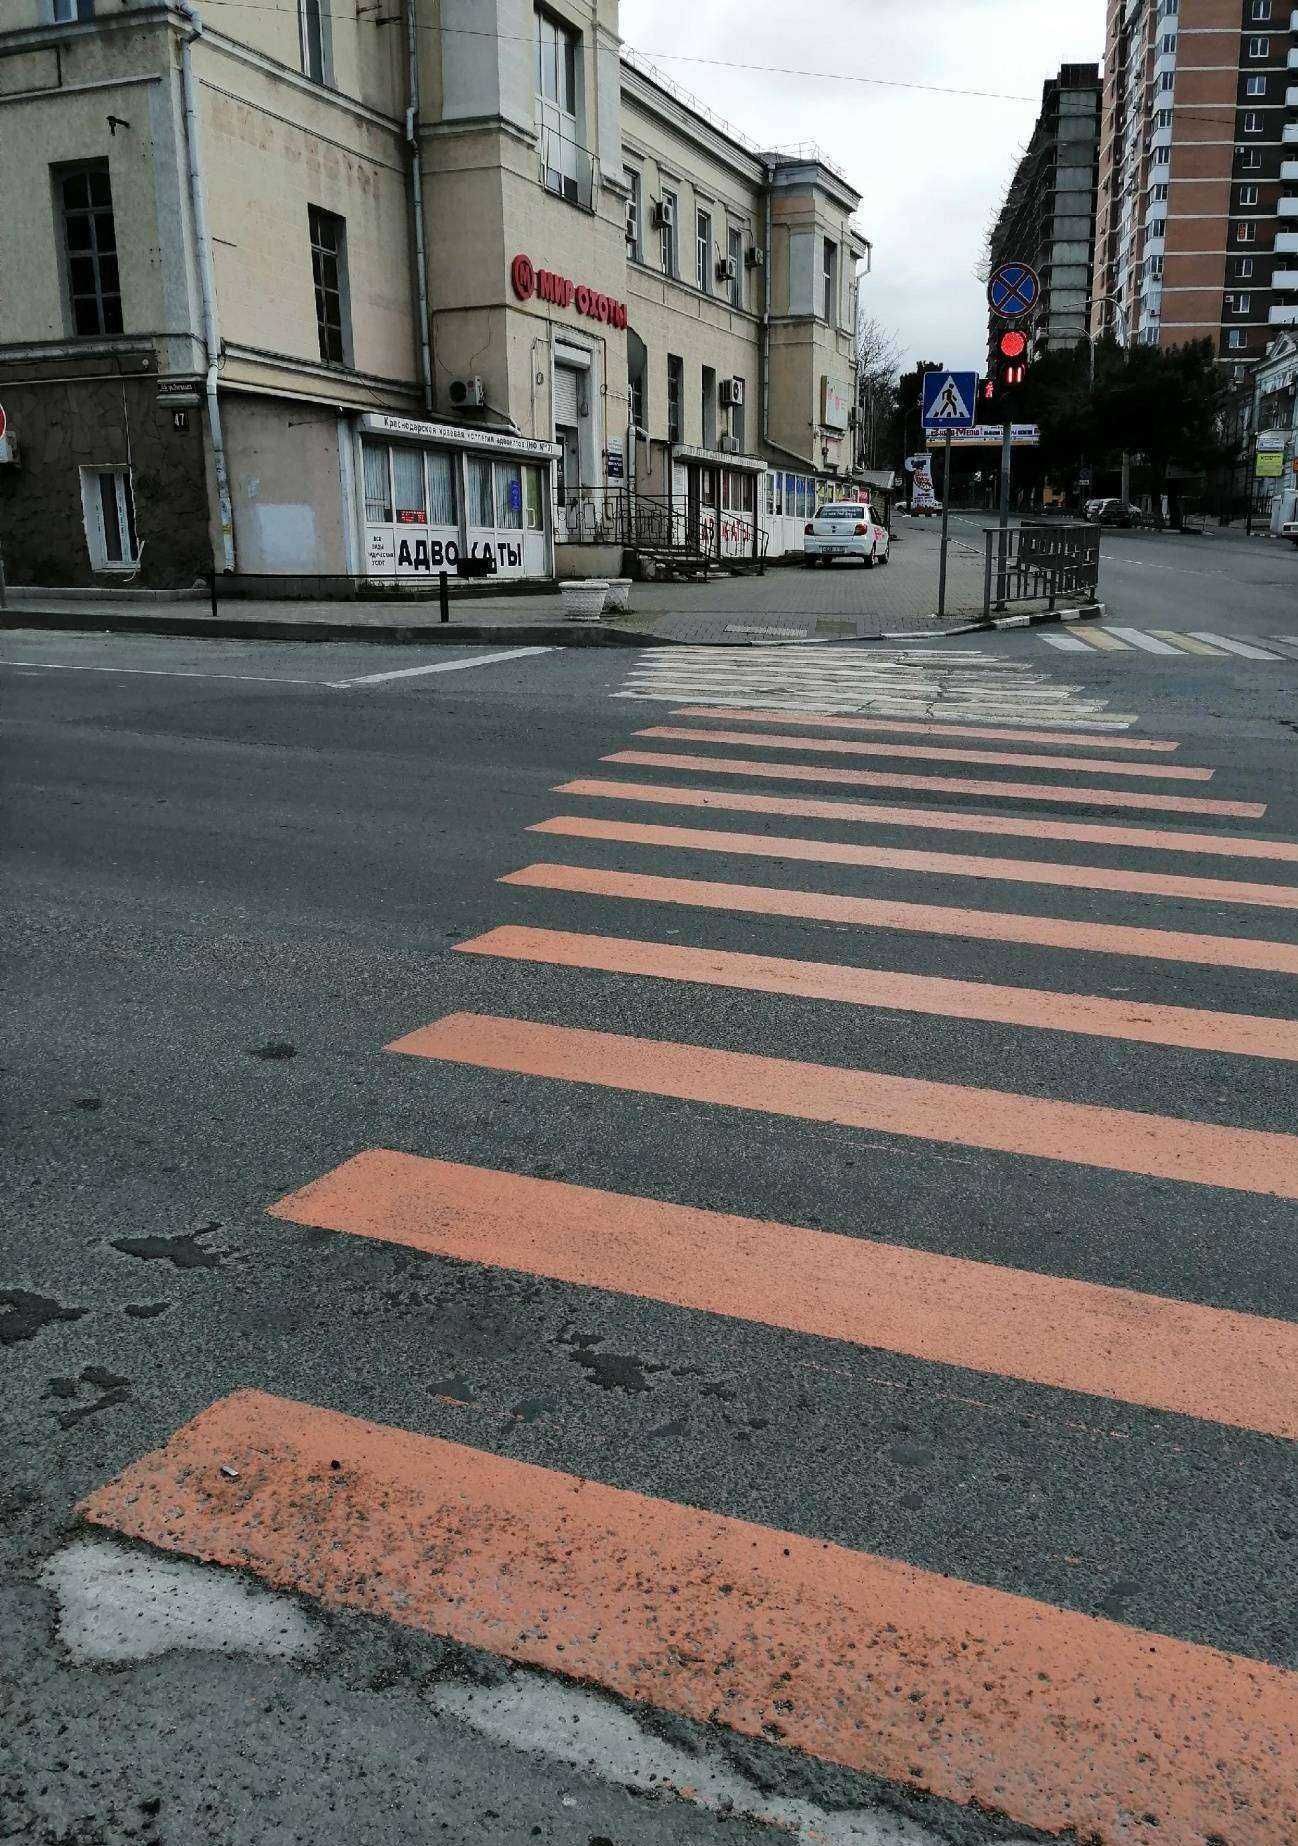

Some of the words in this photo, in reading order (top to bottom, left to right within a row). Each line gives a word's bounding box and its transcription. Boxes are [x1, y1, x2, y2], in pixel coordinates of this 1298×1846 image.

[537, 268, 574, 309] МИР
[574, 285, 628, 331] ОХОТЫ
[174, 413, 185, 426] 47
